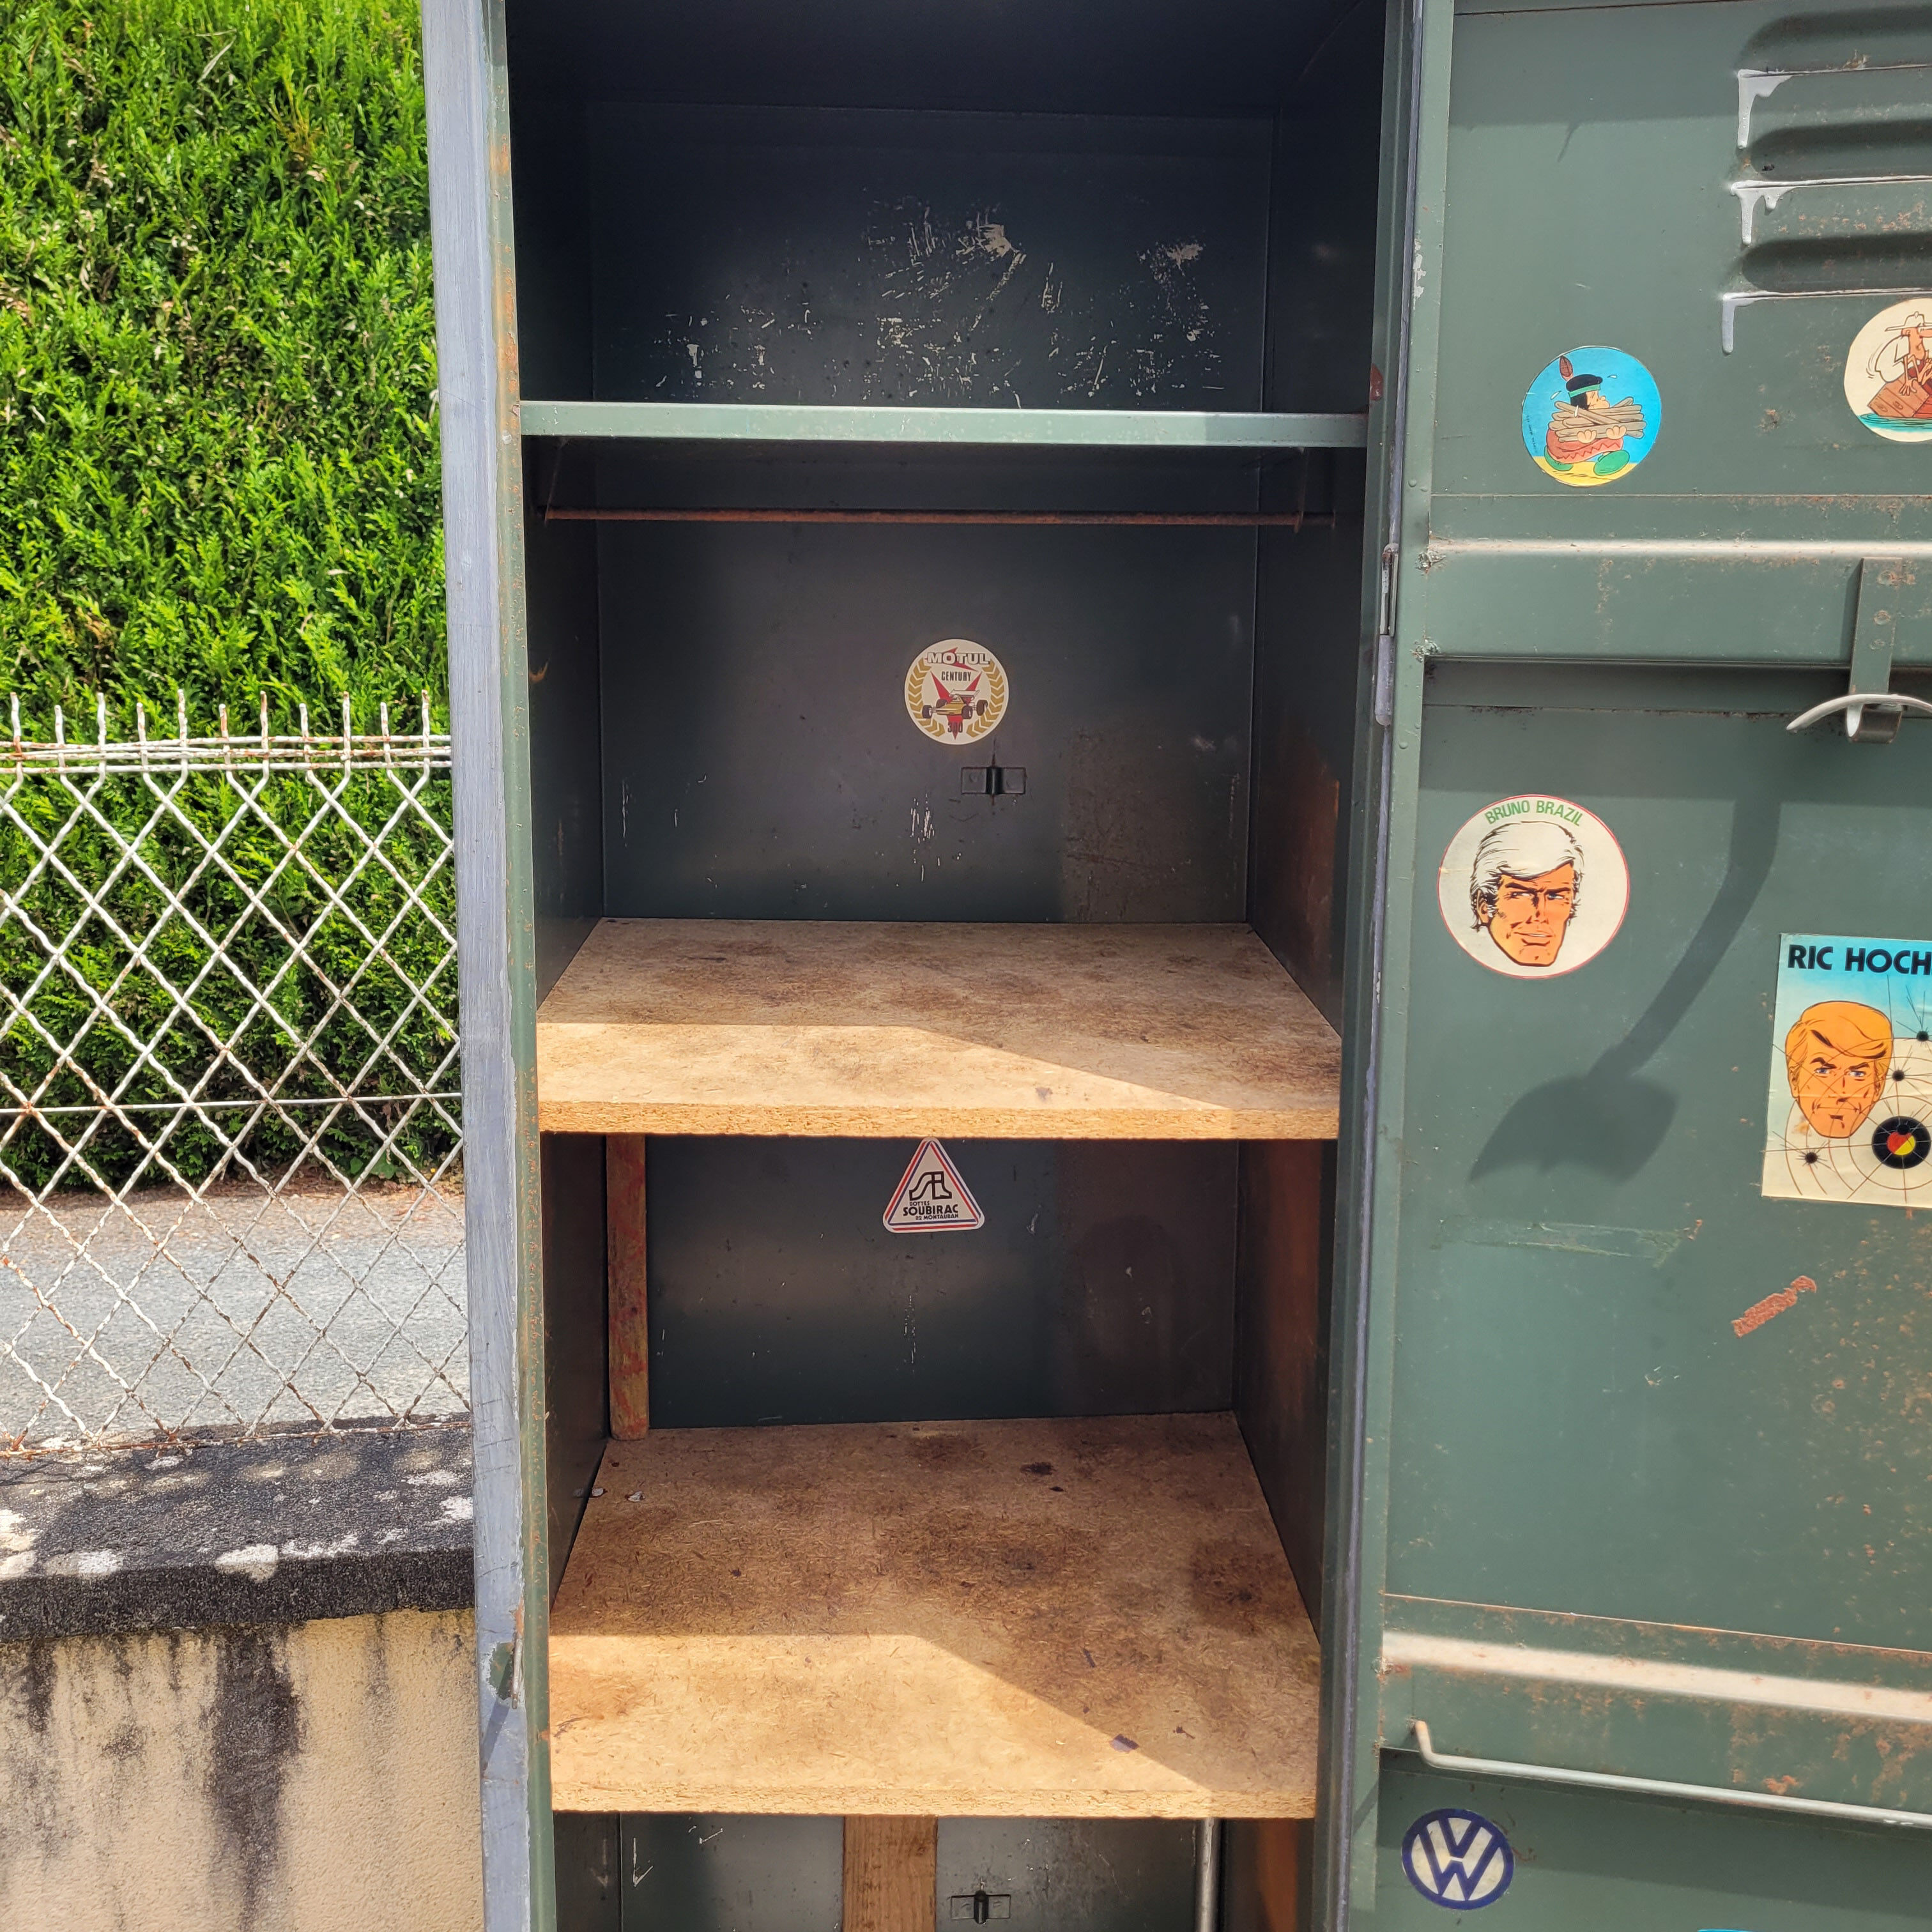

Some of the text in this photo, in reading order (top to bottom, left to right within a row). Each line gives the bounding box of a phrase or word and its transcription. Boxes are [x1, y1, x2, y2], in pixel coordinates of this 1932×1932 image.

[927, 652, 991, 665] MOTUL
[941, 671, 972, 682] CENTURY
[1484, 800, 1583, 826] BRUNO BRAZIL
[1788, 944, 1932, 976] RIC HOCH
[903, 1204, 958, 1216] SOUBIRAC
[1407, 1813, 1509, 1906] VW
